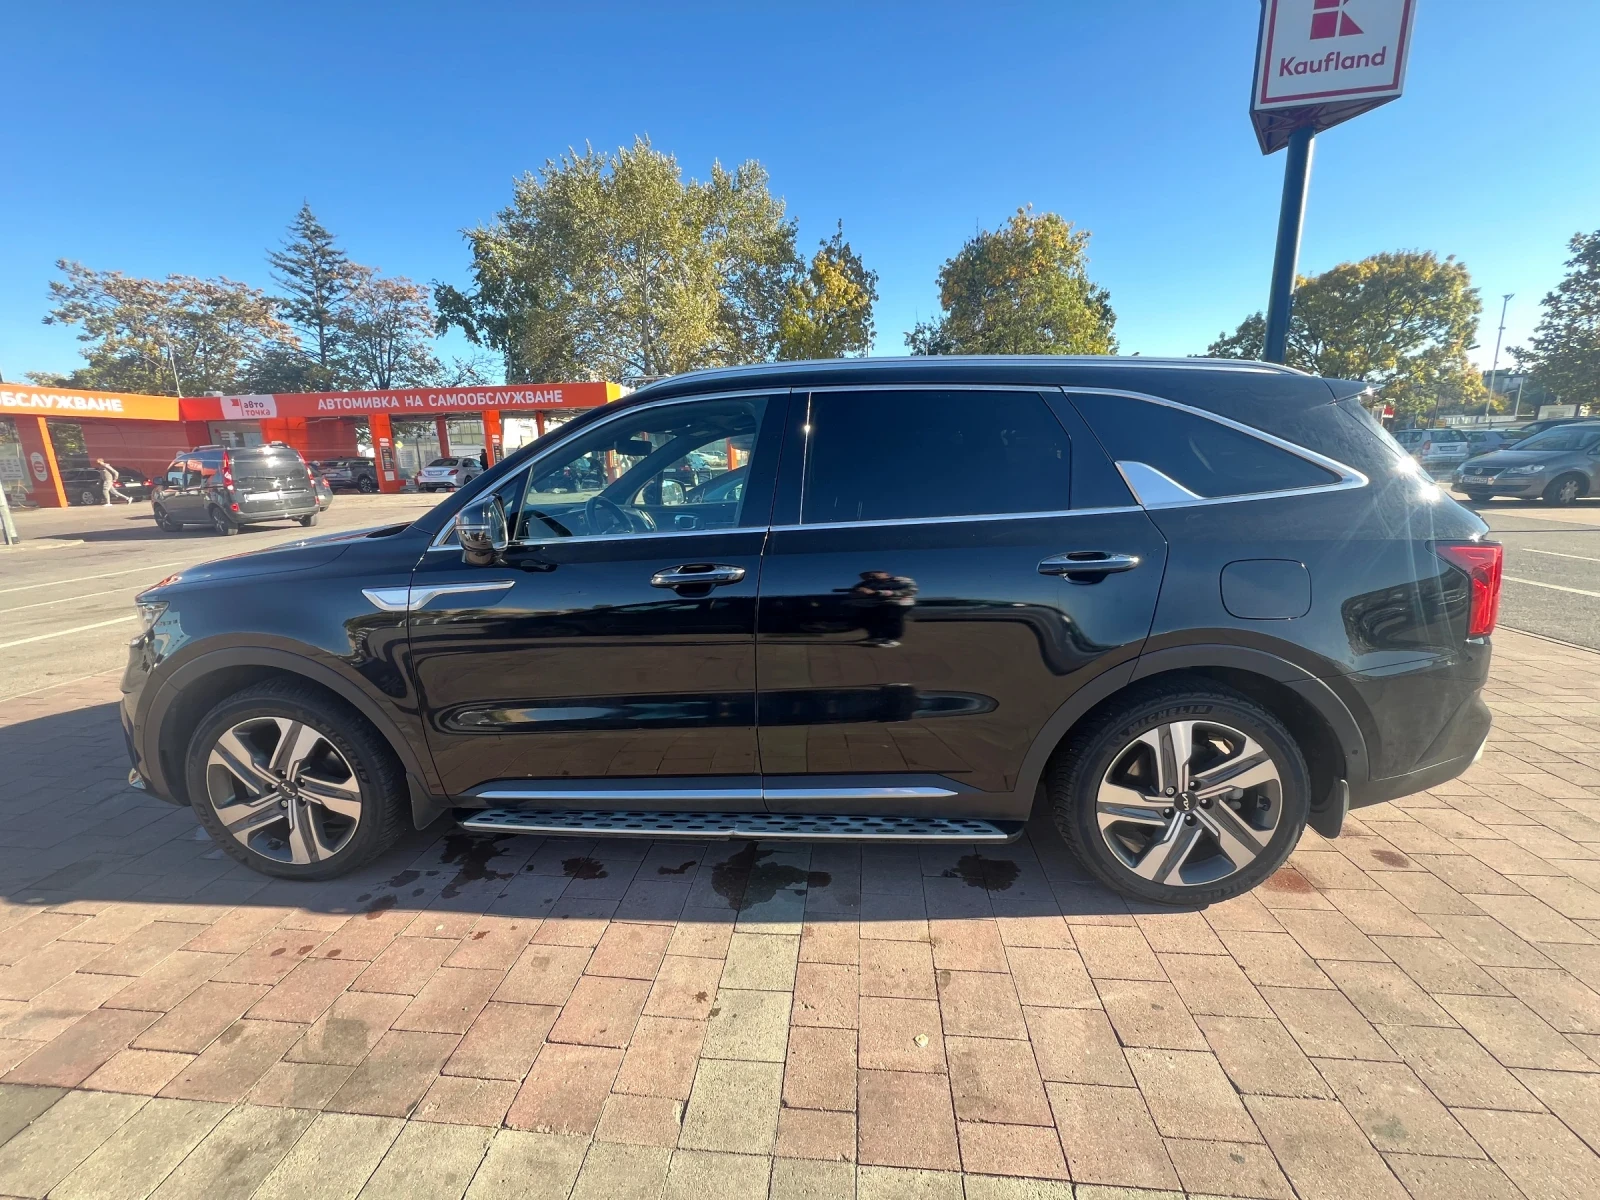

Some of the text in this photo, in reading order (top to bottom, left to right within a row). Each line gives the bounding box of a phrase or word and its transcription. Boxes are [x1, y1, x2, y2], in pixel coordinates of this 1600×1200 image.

[1279, 46, 1387, 77] Kaufland
[0, 391, 124, 412] БСЛУЖВАНЕ
[317, 389, 563, 411] АВТОМИВКА НА САМООБСЛУЖВАНЕ
[245, 408, 271, 416] точка
[1128, 705, 1209, 734] MICHELIN
